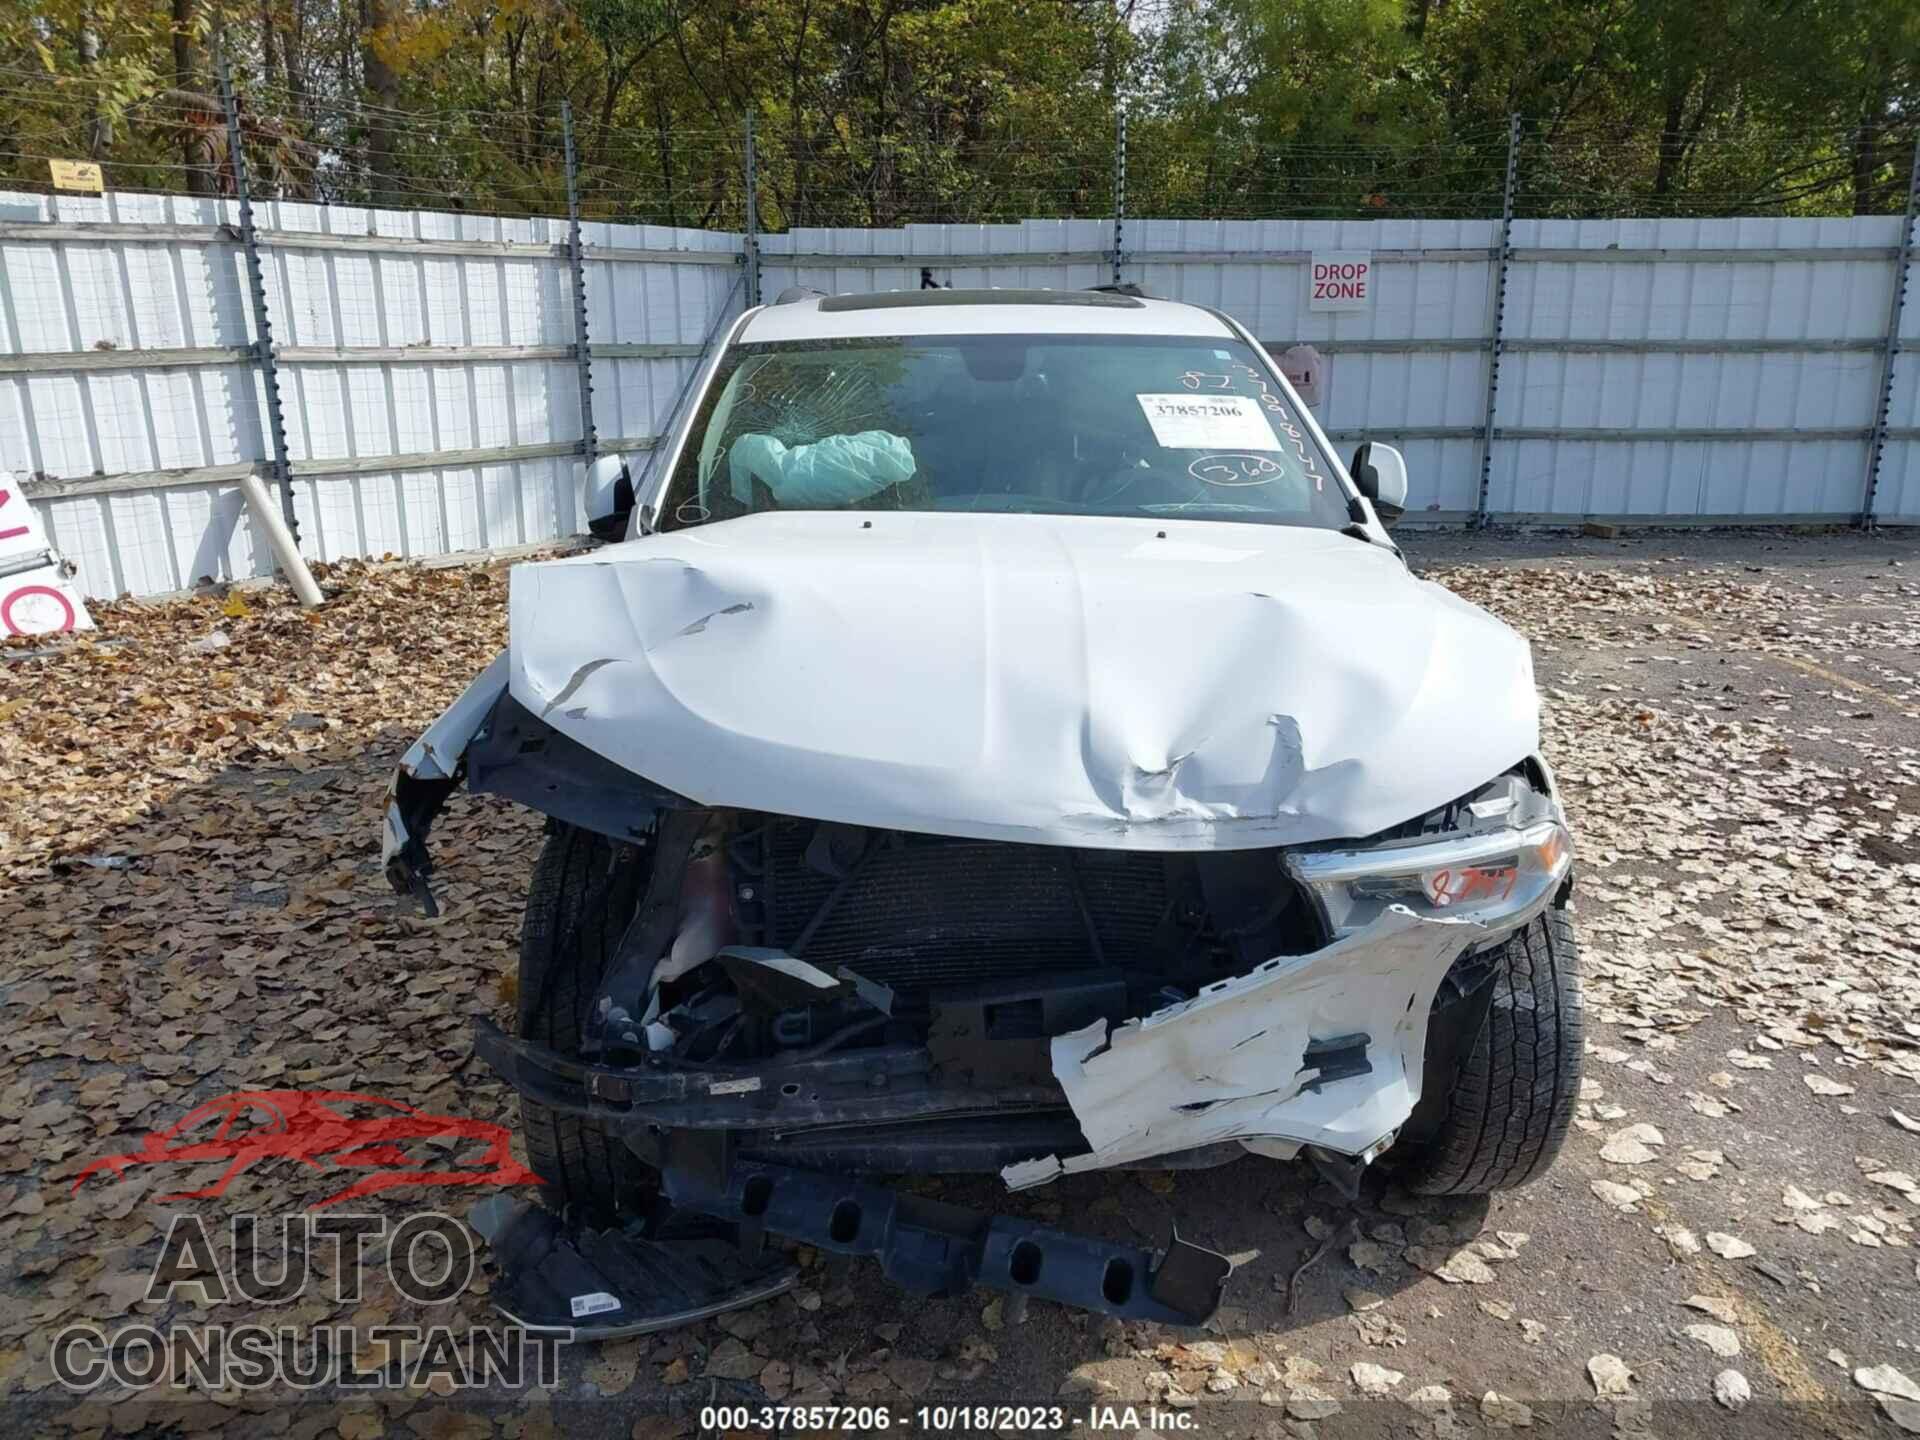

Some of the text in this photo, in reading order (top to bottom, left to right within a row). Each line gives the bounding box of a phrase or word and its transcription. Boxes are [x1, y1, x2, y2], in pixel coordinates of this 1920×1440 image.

[1314, 264, 1367, 280] DROP
[1313, 282, 1366, 299] ZONE
[1155, 404, 1243, 417] 37857206
